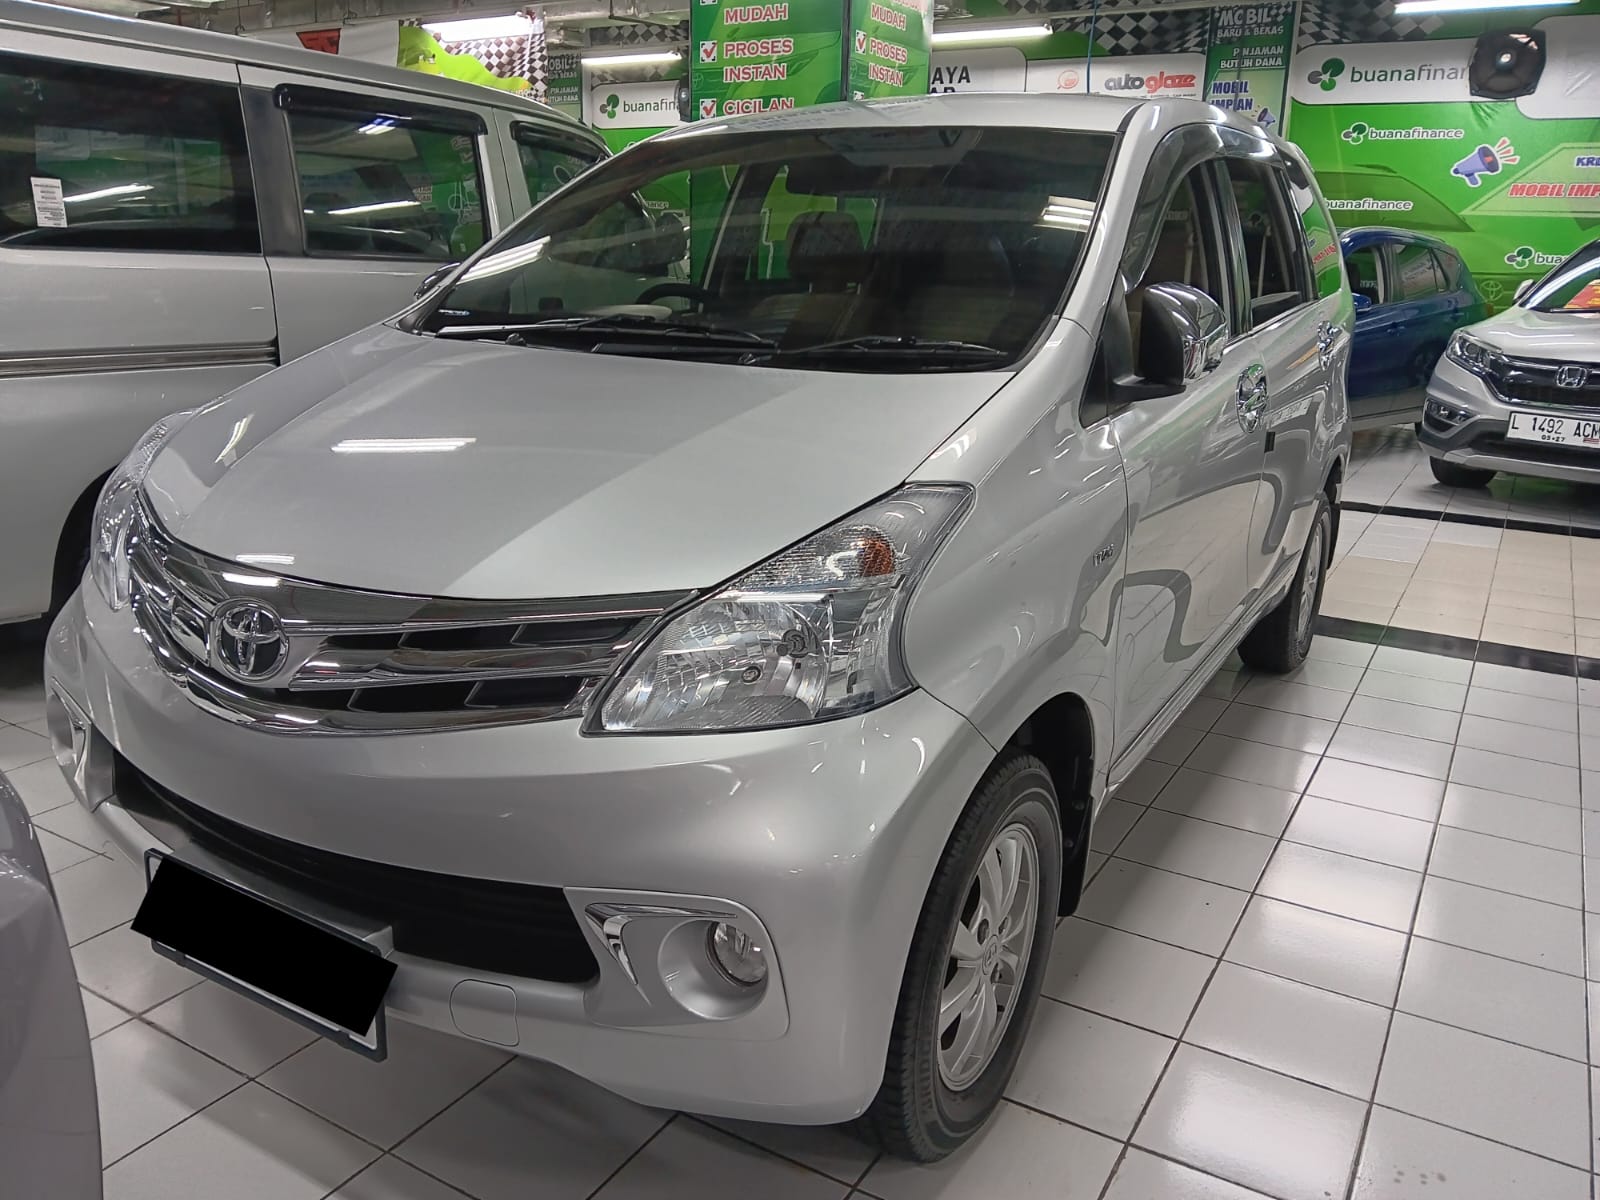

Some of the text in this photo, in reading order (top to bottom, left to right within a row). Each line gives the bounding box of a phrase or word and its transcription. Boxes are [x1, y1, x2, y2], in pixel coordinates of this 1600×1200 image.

[724, 4, 788, 24] MUDAH
[871, 4, 906, 30] MUDAH
[1254, 26, 1284, 35] BEKAS
[724, 39, 793, 58] PROSES
[870, 38, 907, 63] PROSES
[1233, 46, 1284, 56] PNJAMAN
[1255, 58, 1282, 66] DANA
[724, 64, 786, 82] INSTAN
[869, 63, 903, 86] INSTAN
[1104, 71, 1196, 94] autoglaze
[1212, 81, 1249, 94] MOBIL
[623, 98, 680, 113] buanafin
[723, 99, 794, 115] CICILAN
[1211, 98, 1252, 111] MPAN
[1369, 127, 1464, 139] buanafinance
[1509, 184, 1600, 196] MOBIL IMP
[1535, 253, 1566, 264] bua
[1511, 415, 1600, 439] L 1492 ACM
